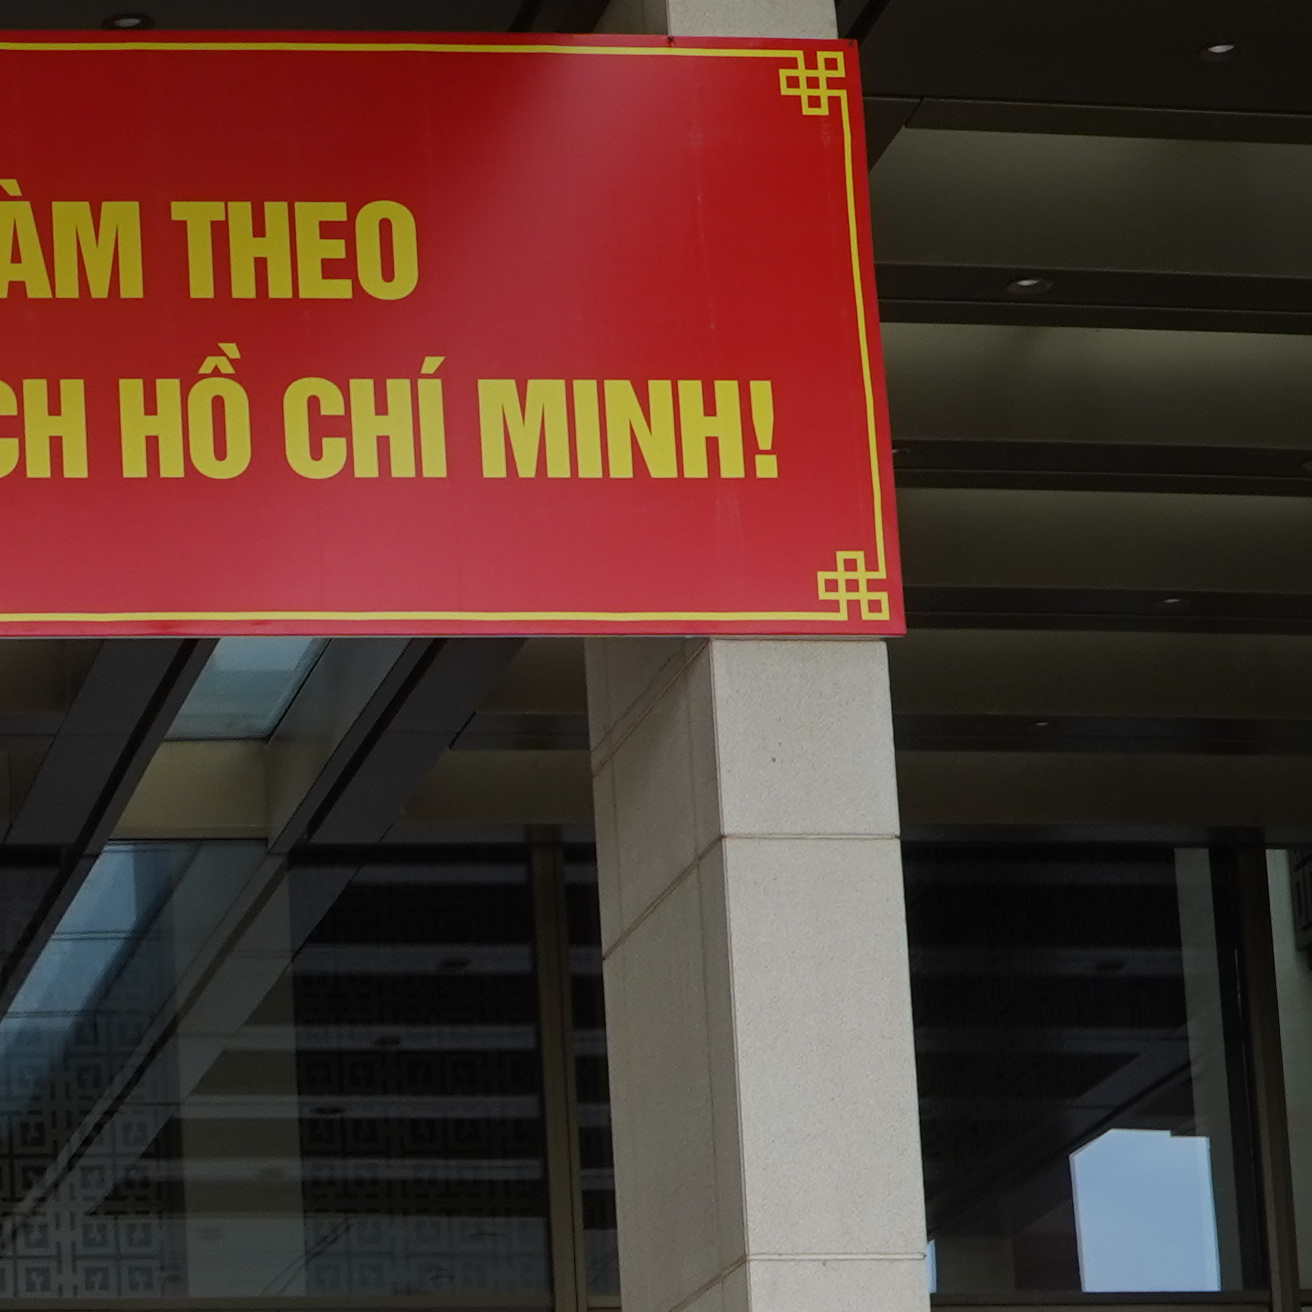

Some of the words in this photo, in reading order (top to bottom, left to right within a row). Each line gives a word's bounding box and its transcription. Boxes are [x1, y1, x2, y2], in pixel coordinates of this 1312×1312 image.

[172, 201, 418, 299] THEO
[120, 342, 250, 479] HỒ
[284, 356, 446, 479] CHÍ
[479, 377, 777, 478] MINH!
